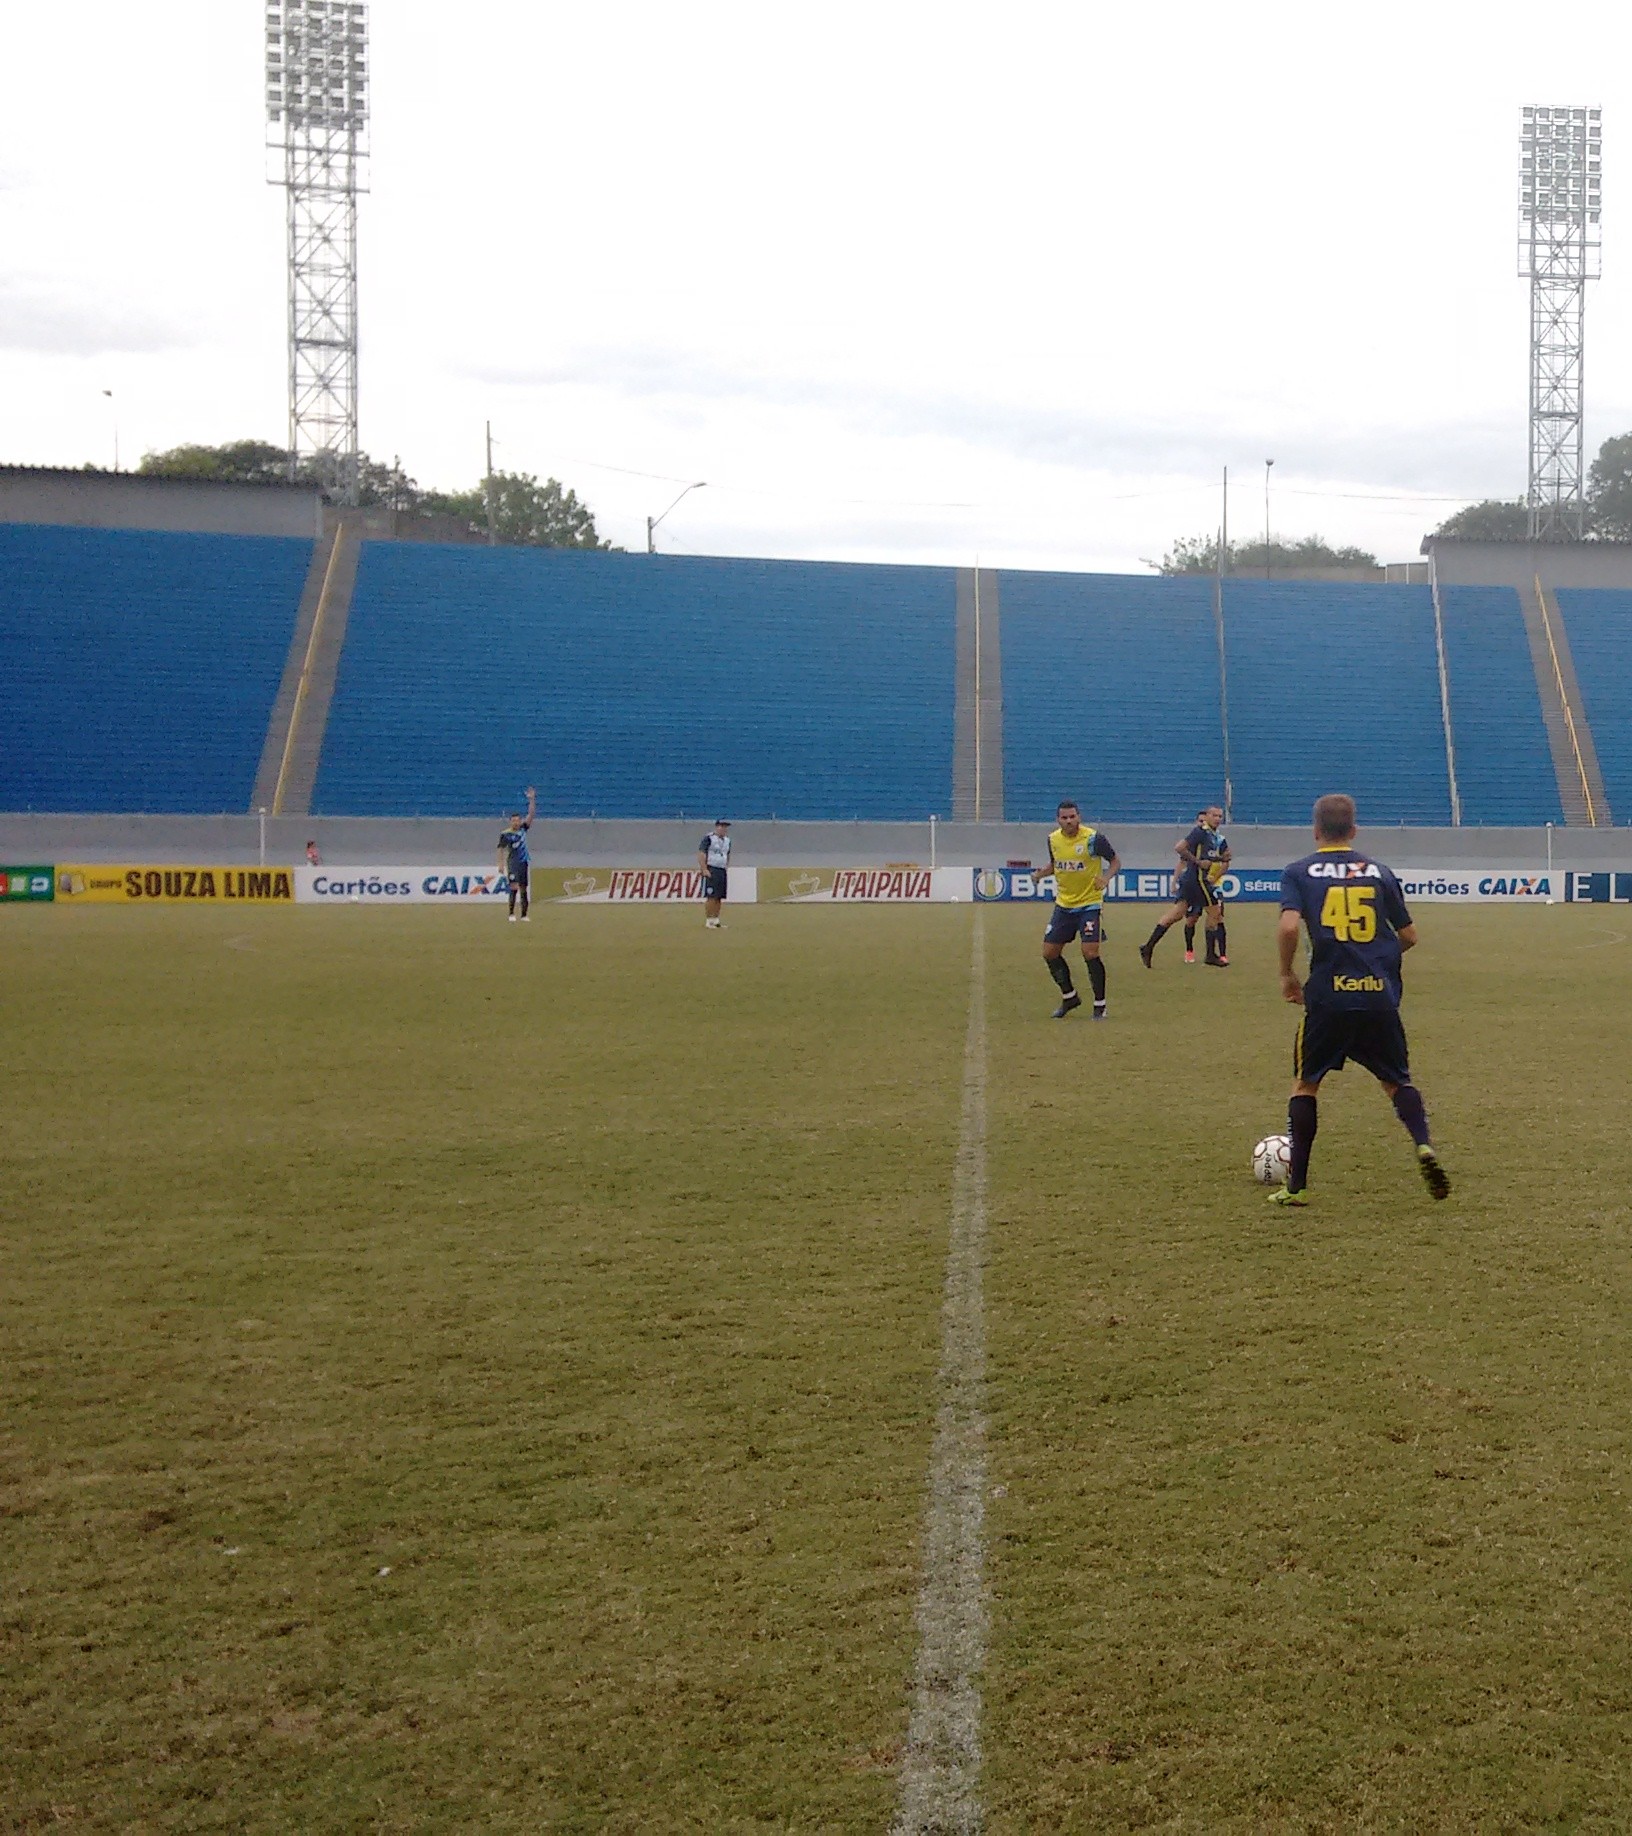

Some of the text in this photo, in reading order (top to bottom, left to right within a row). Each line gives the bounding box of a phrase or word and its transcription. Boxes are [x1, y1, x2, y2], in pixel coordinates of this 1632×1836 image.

[1307, 862, 1381, 879] CAIXA
[126, 871, 216, 898] SOUZA
[224, 871, 292, 899] LIMA
[313, 876, 511, 895] Cartões CAIXA
[832, 871, 932, 898] ITAIPAVA
[1479, 878, 1550, 895] CAIXA
[1320, 886, 1377, 943] 45
[1333, 975, 1384, 992] Karilu
